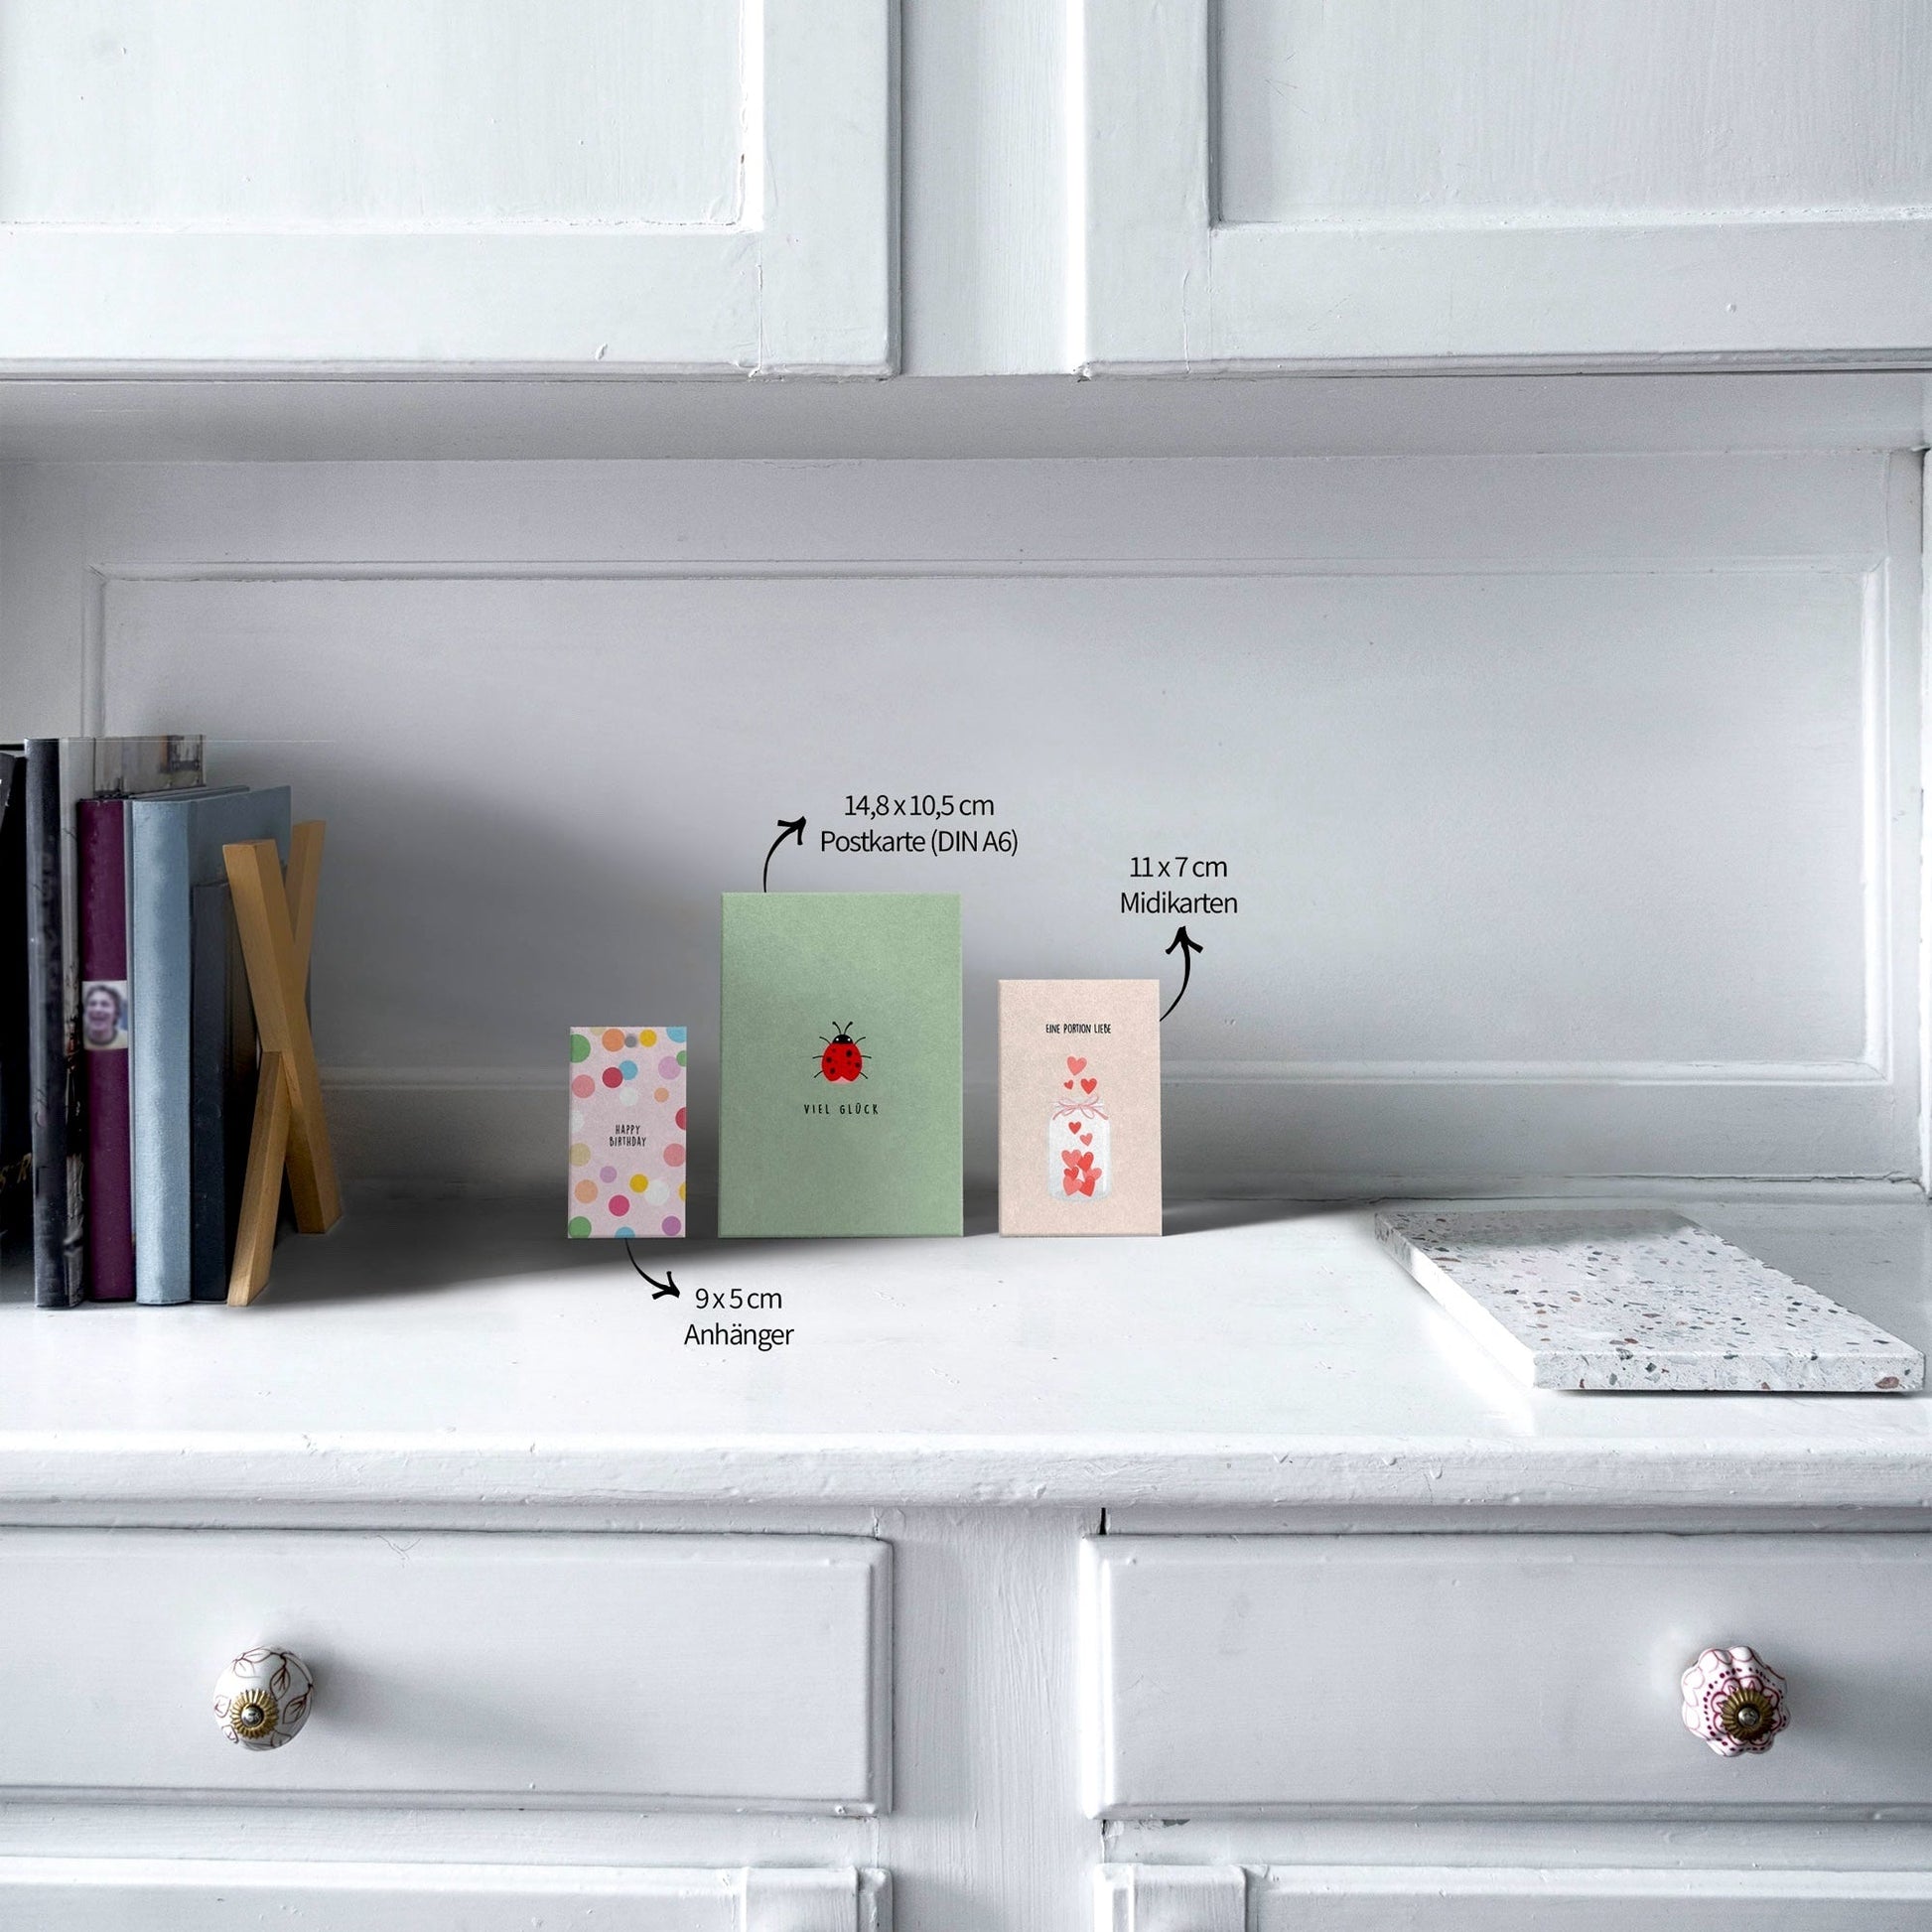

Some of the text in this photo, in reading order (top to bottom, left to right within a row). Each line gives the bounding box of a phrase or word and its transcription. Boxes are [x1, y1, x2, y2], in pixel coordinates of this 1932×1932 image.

[1045, 1023, 1112, 1035] EINE PORTION LIEBE
[803, 1102, 879, 1115] VIEL GLÜCK
[616, 1124, 640, 1135] HAPPY
[609, 1136, 646, 1148] BIRTHDAY
